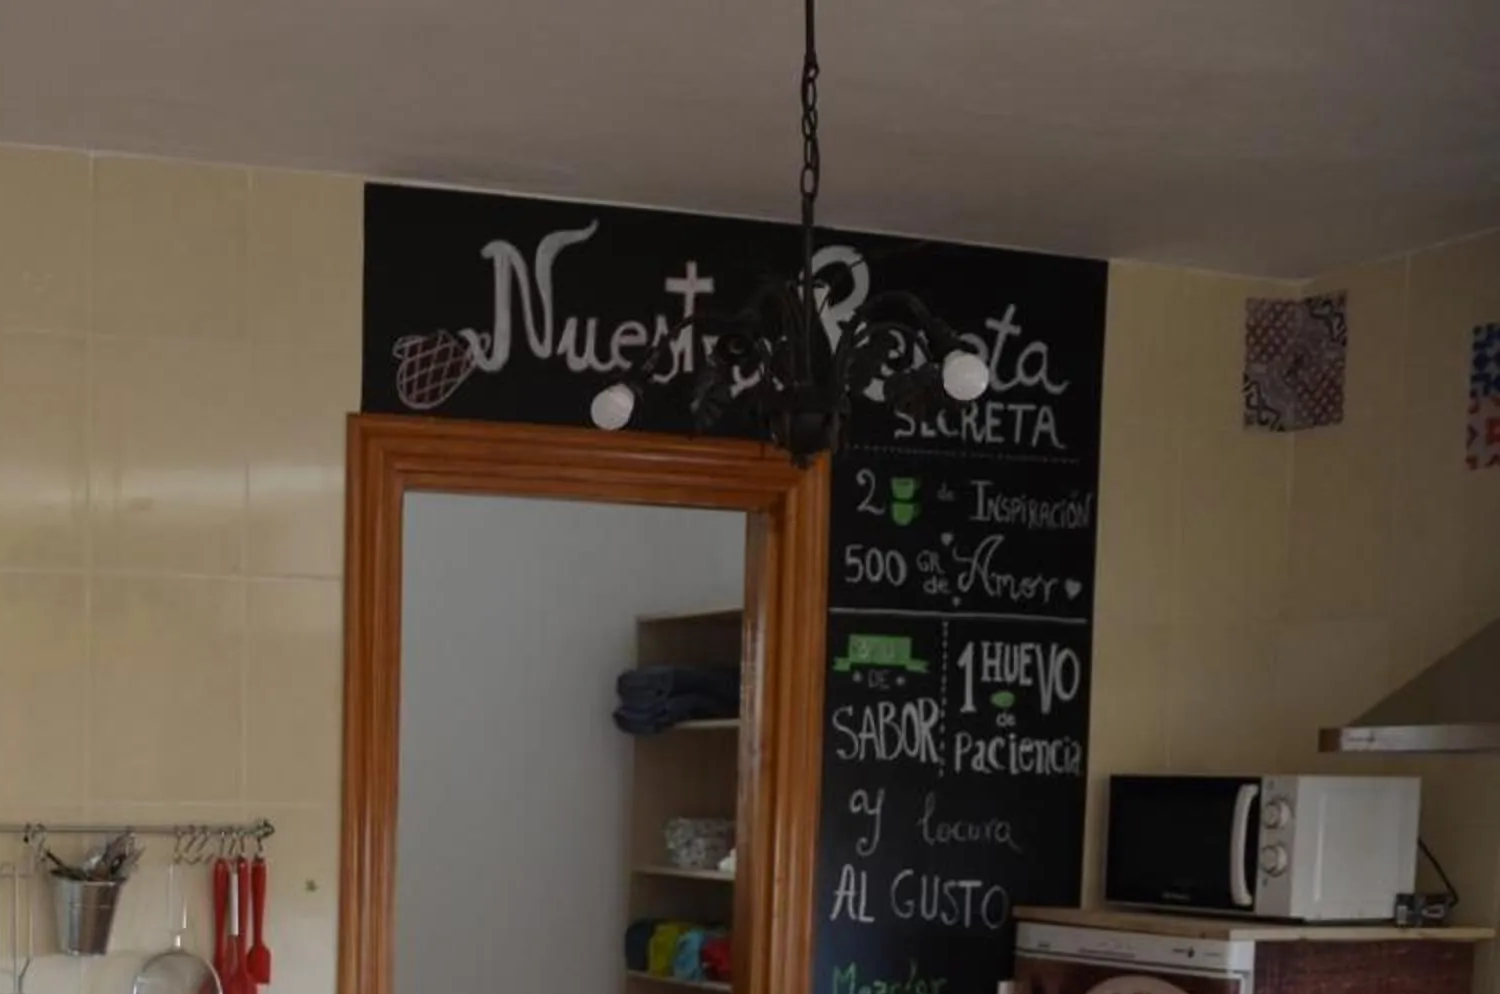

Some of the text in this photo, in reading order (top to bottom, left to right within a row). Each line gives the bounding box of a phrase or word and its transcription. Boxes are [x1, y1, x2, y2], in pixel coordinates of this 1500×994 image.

[855, 468, 885, 515] 2
[844, 544, 908, 587] 500
[922, 576, 952, 595] de
[951, 534, 1060, 603] Amor
[956, 640, 1080, 714] 1 HUEVO
[832, 697, 940, 763] SABOR
[954, 731, 1082, 776] Paciencia
[830, 863, 1009, 929] AL GUSTO
